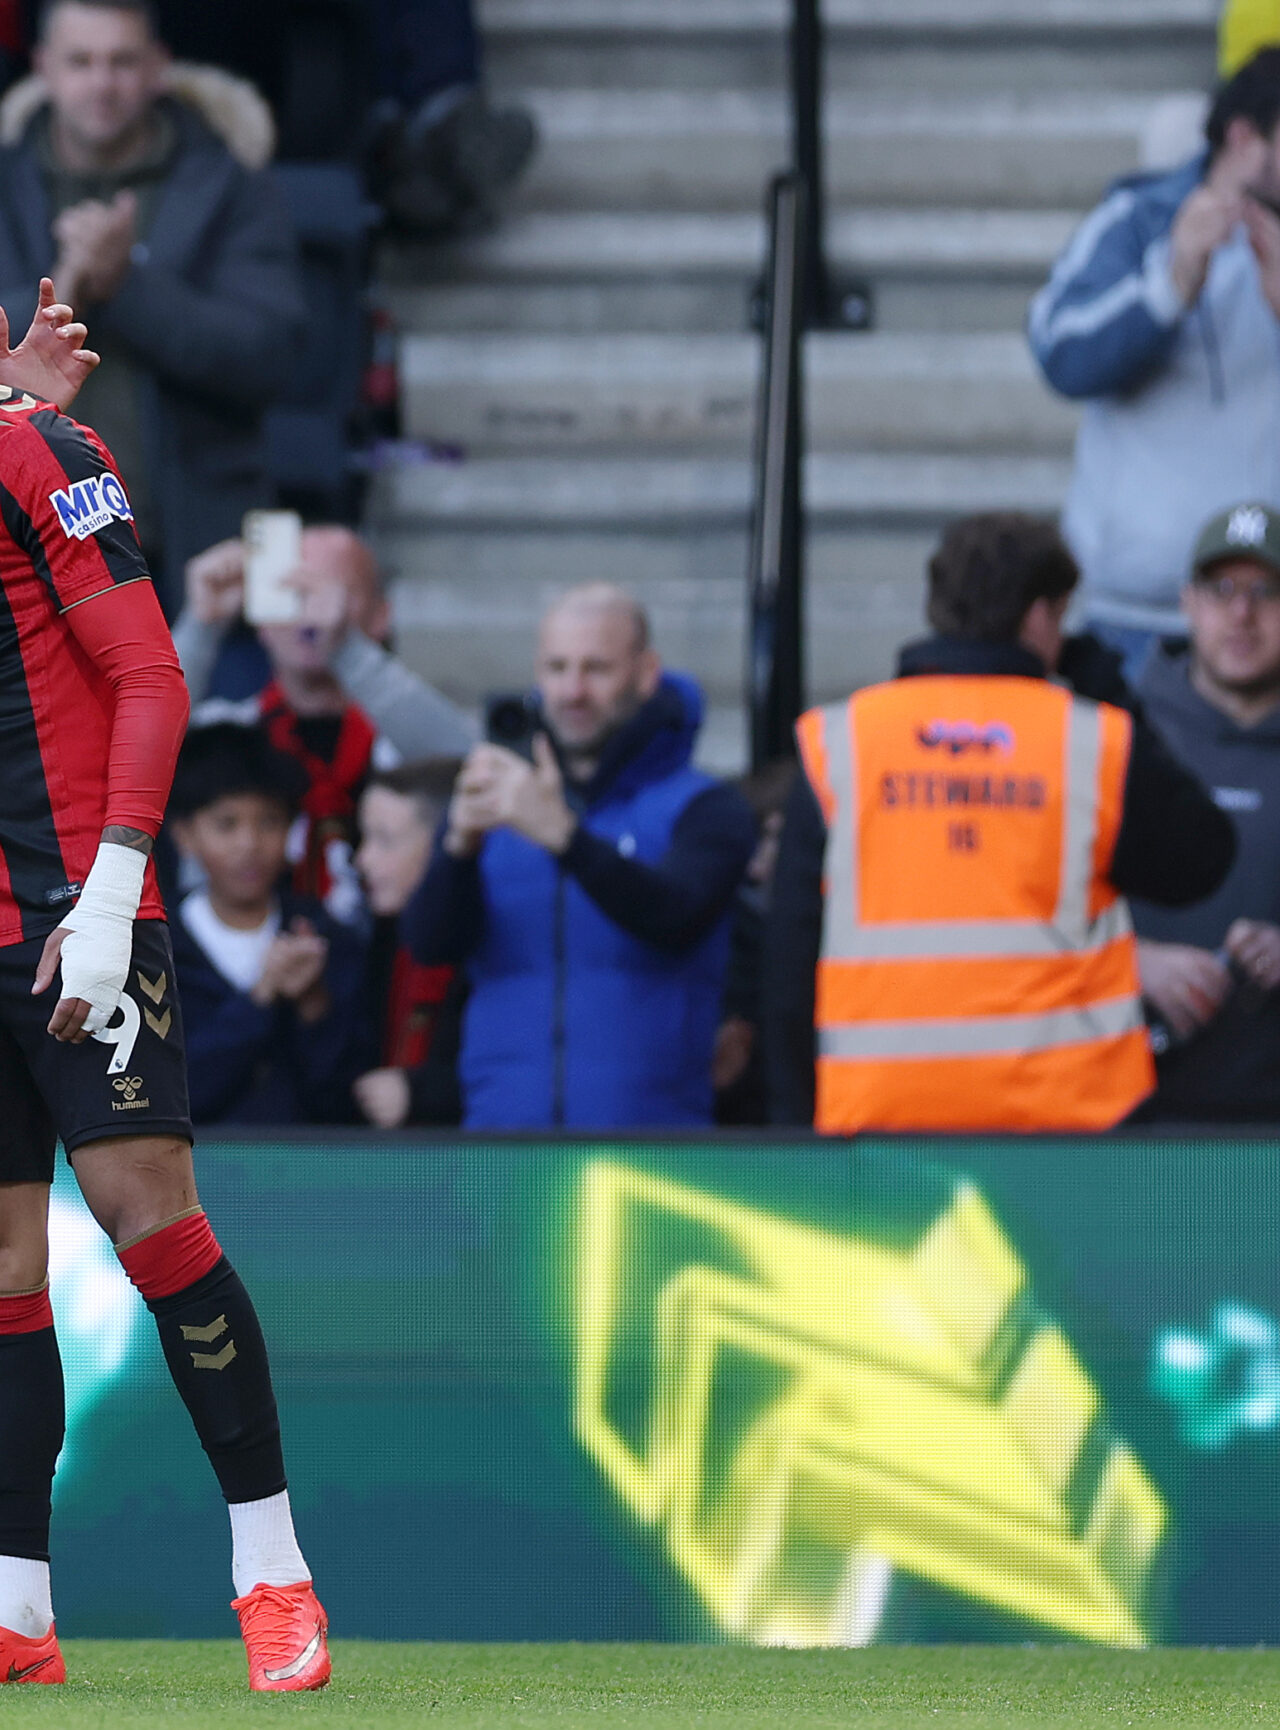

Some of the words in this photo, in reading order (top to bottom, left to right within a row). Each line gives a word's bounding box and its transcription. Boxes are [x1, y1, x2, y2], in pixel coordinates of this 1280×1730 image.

[77, 513, 109, 535] casino
[880, 771, 1045, 807] STEWARD
[91, 991, 140, 1074] 9
[111, 1098, 149, 1111] hummel
